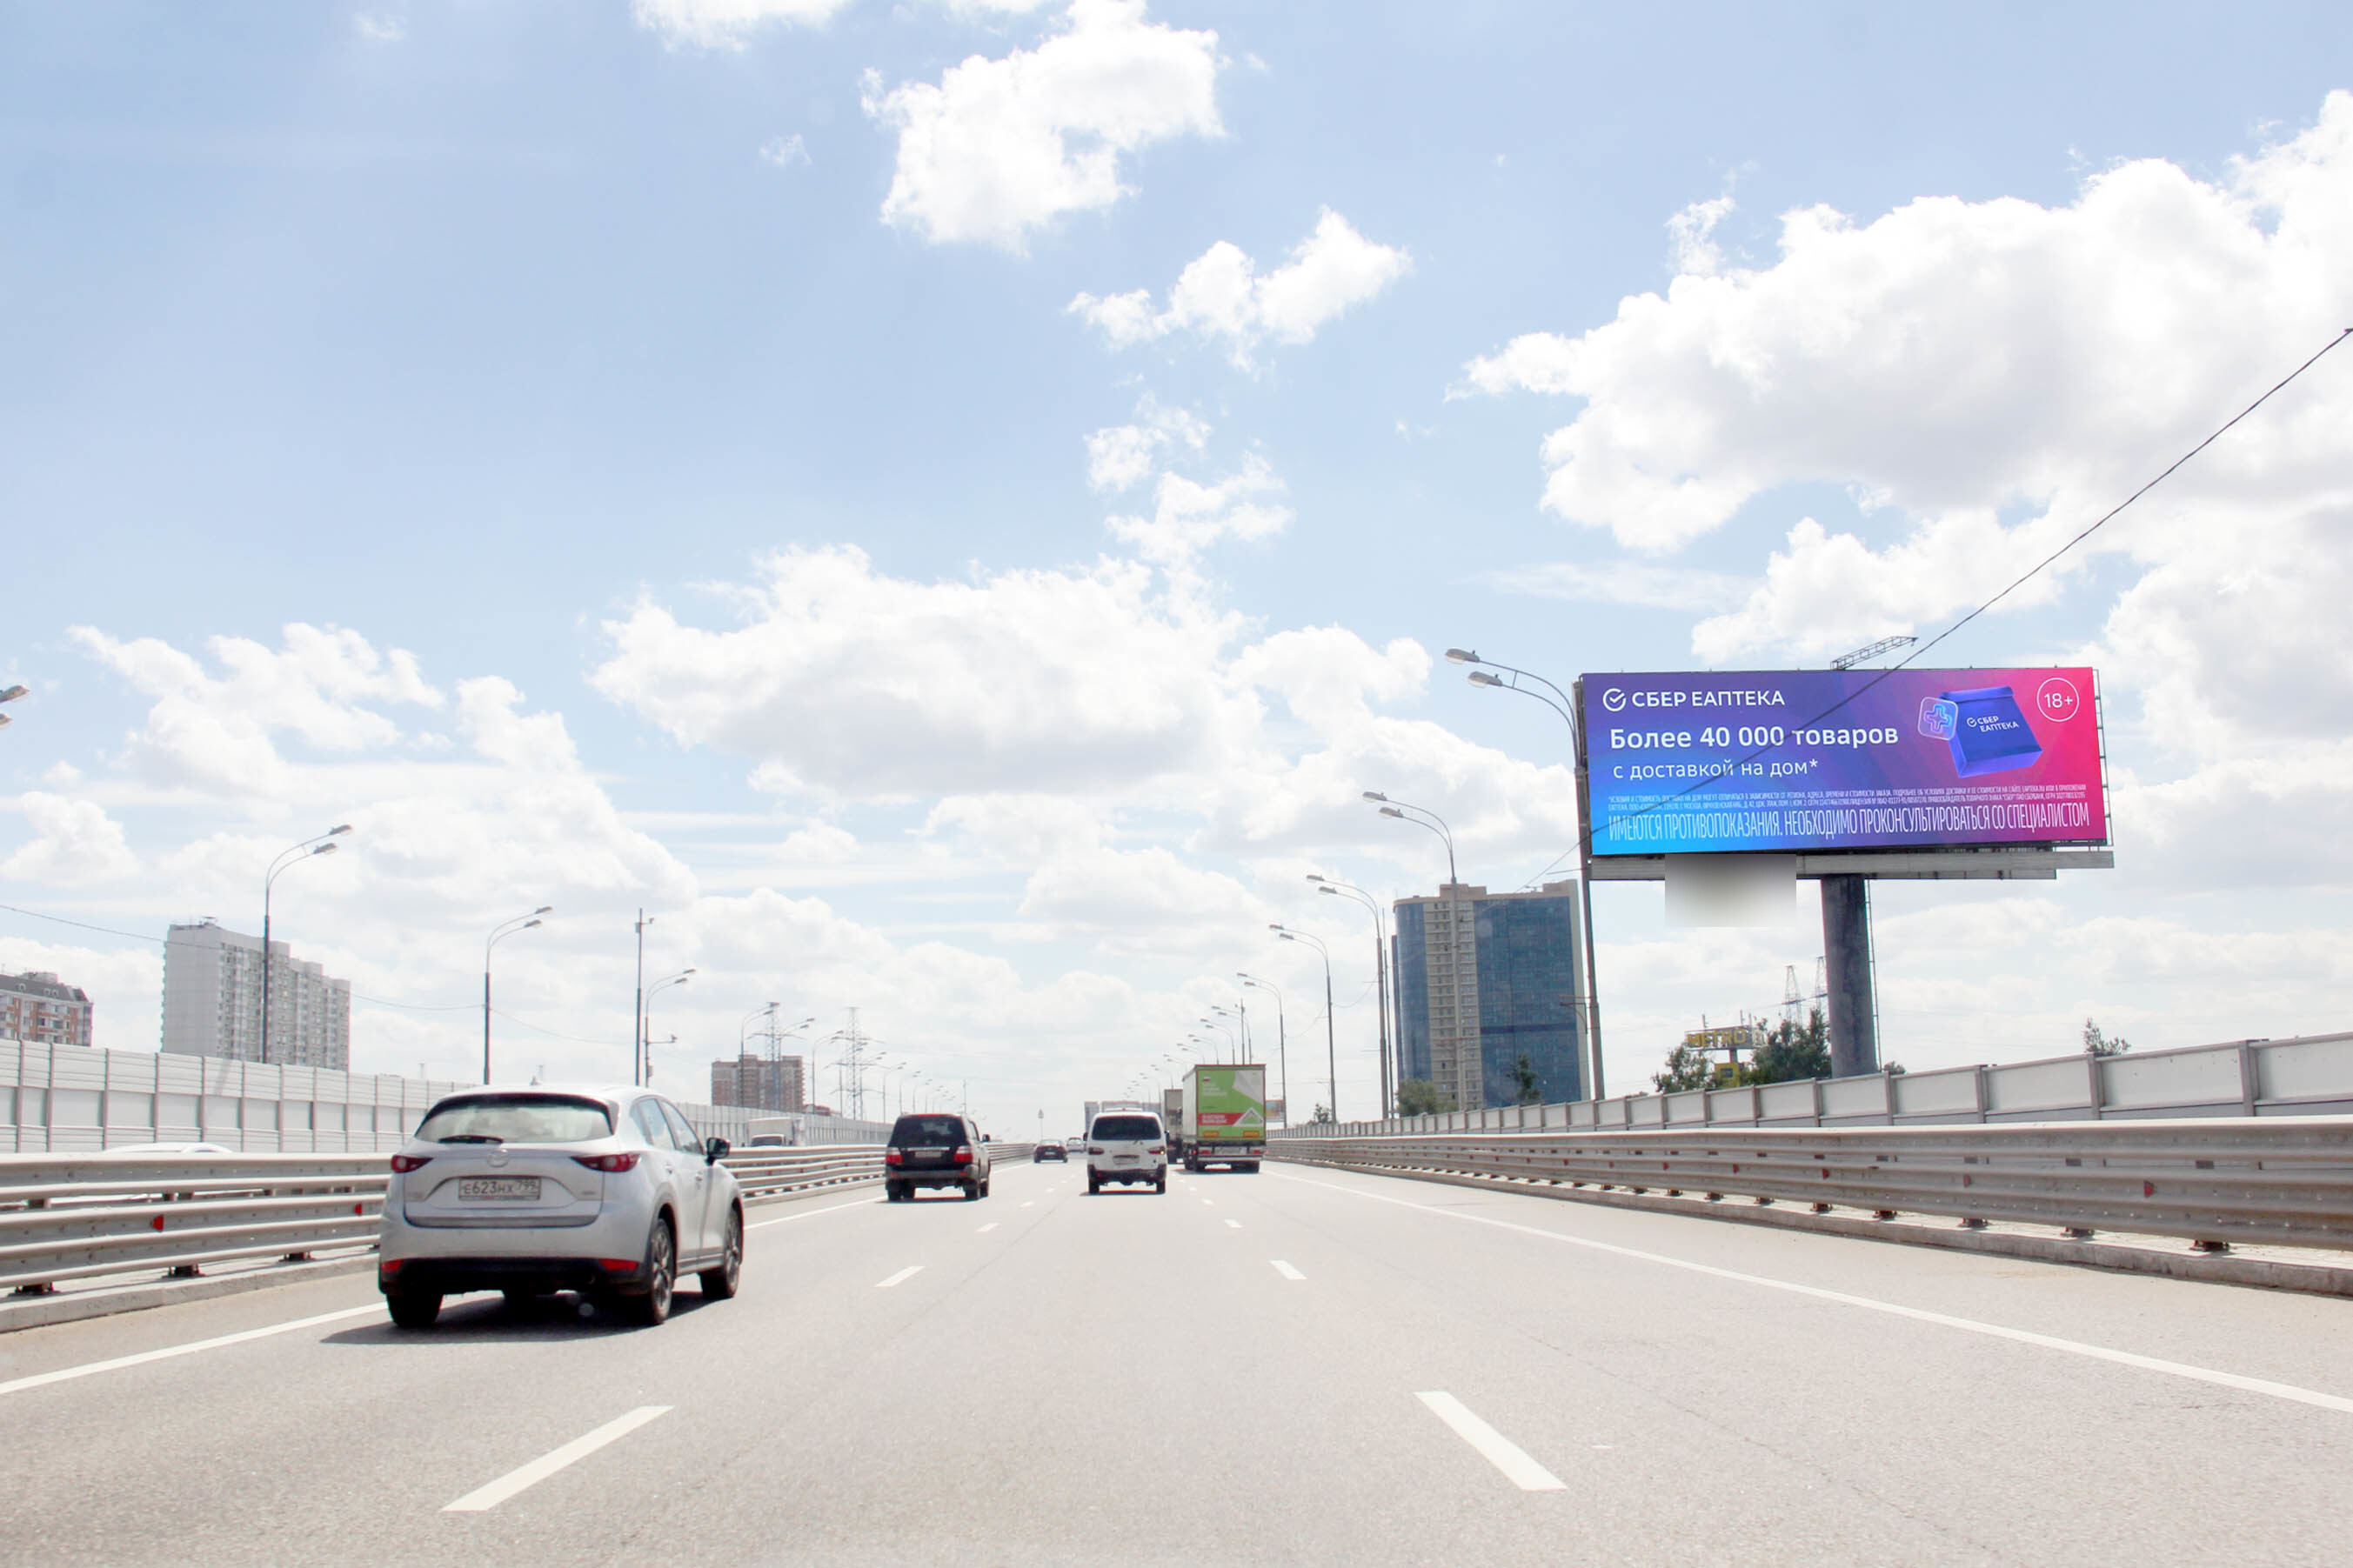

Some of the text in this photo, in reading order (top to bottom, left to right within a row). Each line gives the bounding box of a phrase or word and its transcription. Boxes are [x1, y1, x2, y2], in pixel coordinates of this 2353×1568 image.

[1632, 691, 1785, 708] СБЕР ЕАПТЕКА
[2043, 692, 2074, 709] 18+
[1977, 715, 1999, 726] СБЕР
[1980, 720, 2020, 733] ЕАПТЕКА
[1610, 726, 1899, 750] Более 40 000 товаров
[1613, 764, 1624, 779] с
[1629, 759, 1734, 781] доставкой
[1741, 762, 1763, 777] на
[1608, 802, 2090, 841] ИМЕЮТСЯ ПРОТИВОПОКАЗАНИЯ. НЕОБХОДИМО ПРОКОНСУЛЬТИРОВАТЬСЯ СО СПЕЦИАЛИСТОМ
